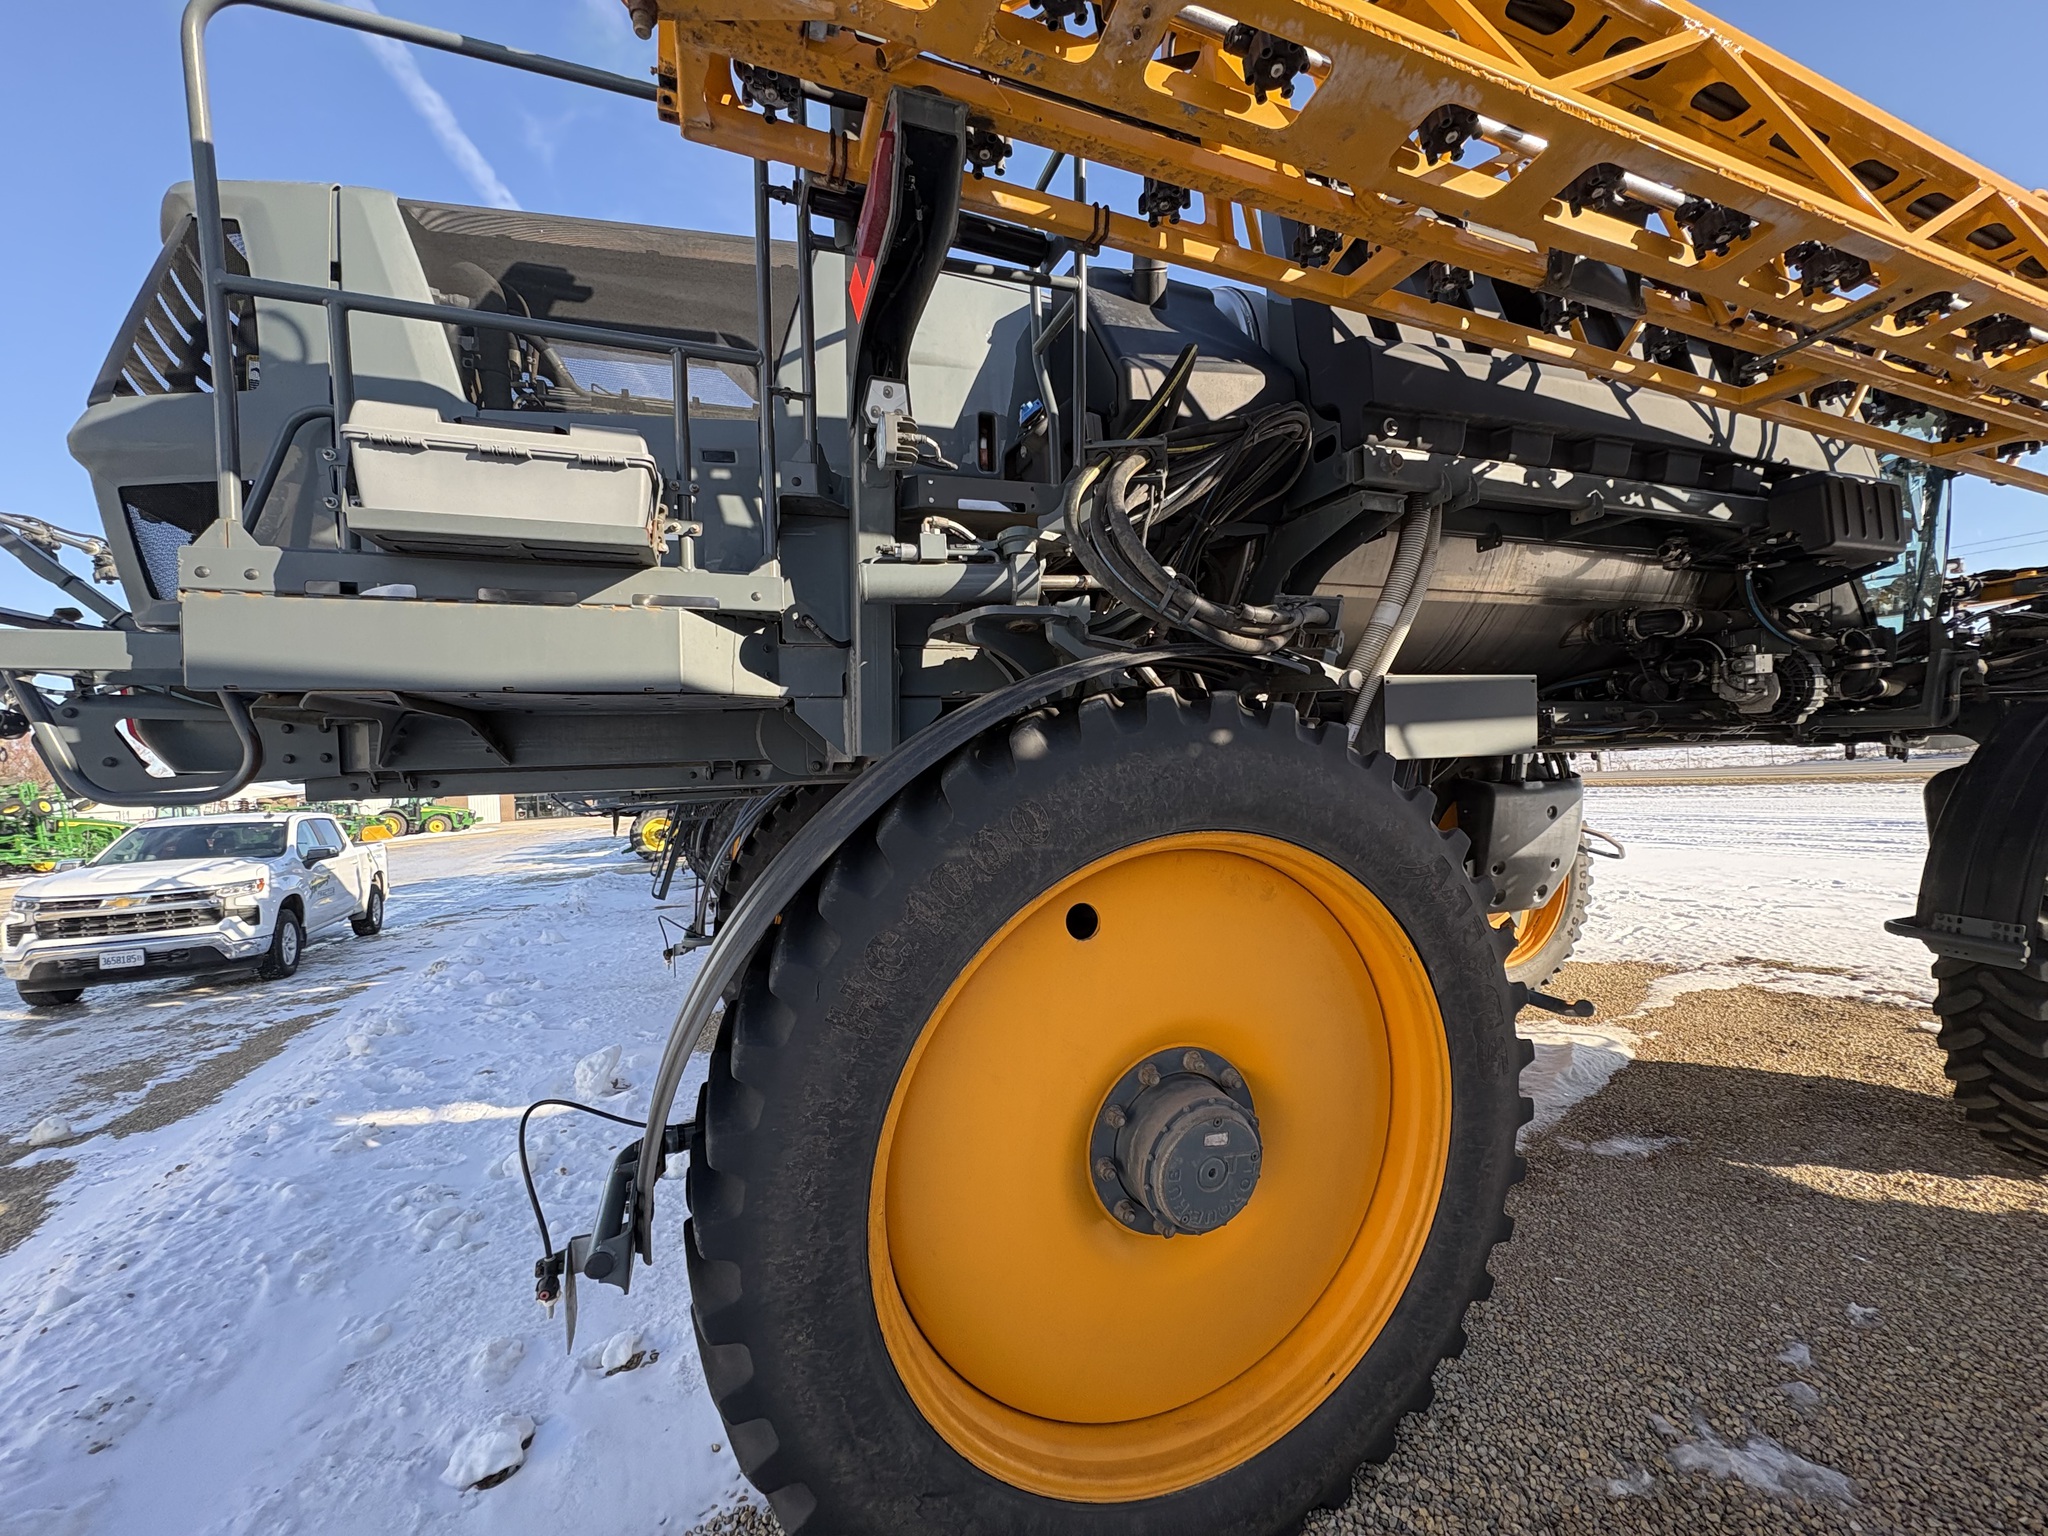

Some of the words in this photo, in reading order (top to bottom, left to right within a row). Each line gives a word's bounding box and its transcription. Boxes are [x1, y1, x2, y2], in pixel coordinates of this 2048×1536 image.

[1579, 862, 1587, 891] 105
[825, 928, 917, 1040] HC
[902, 799, 1051, 937] 1000
[102, 954, 137, 966] 3658185
